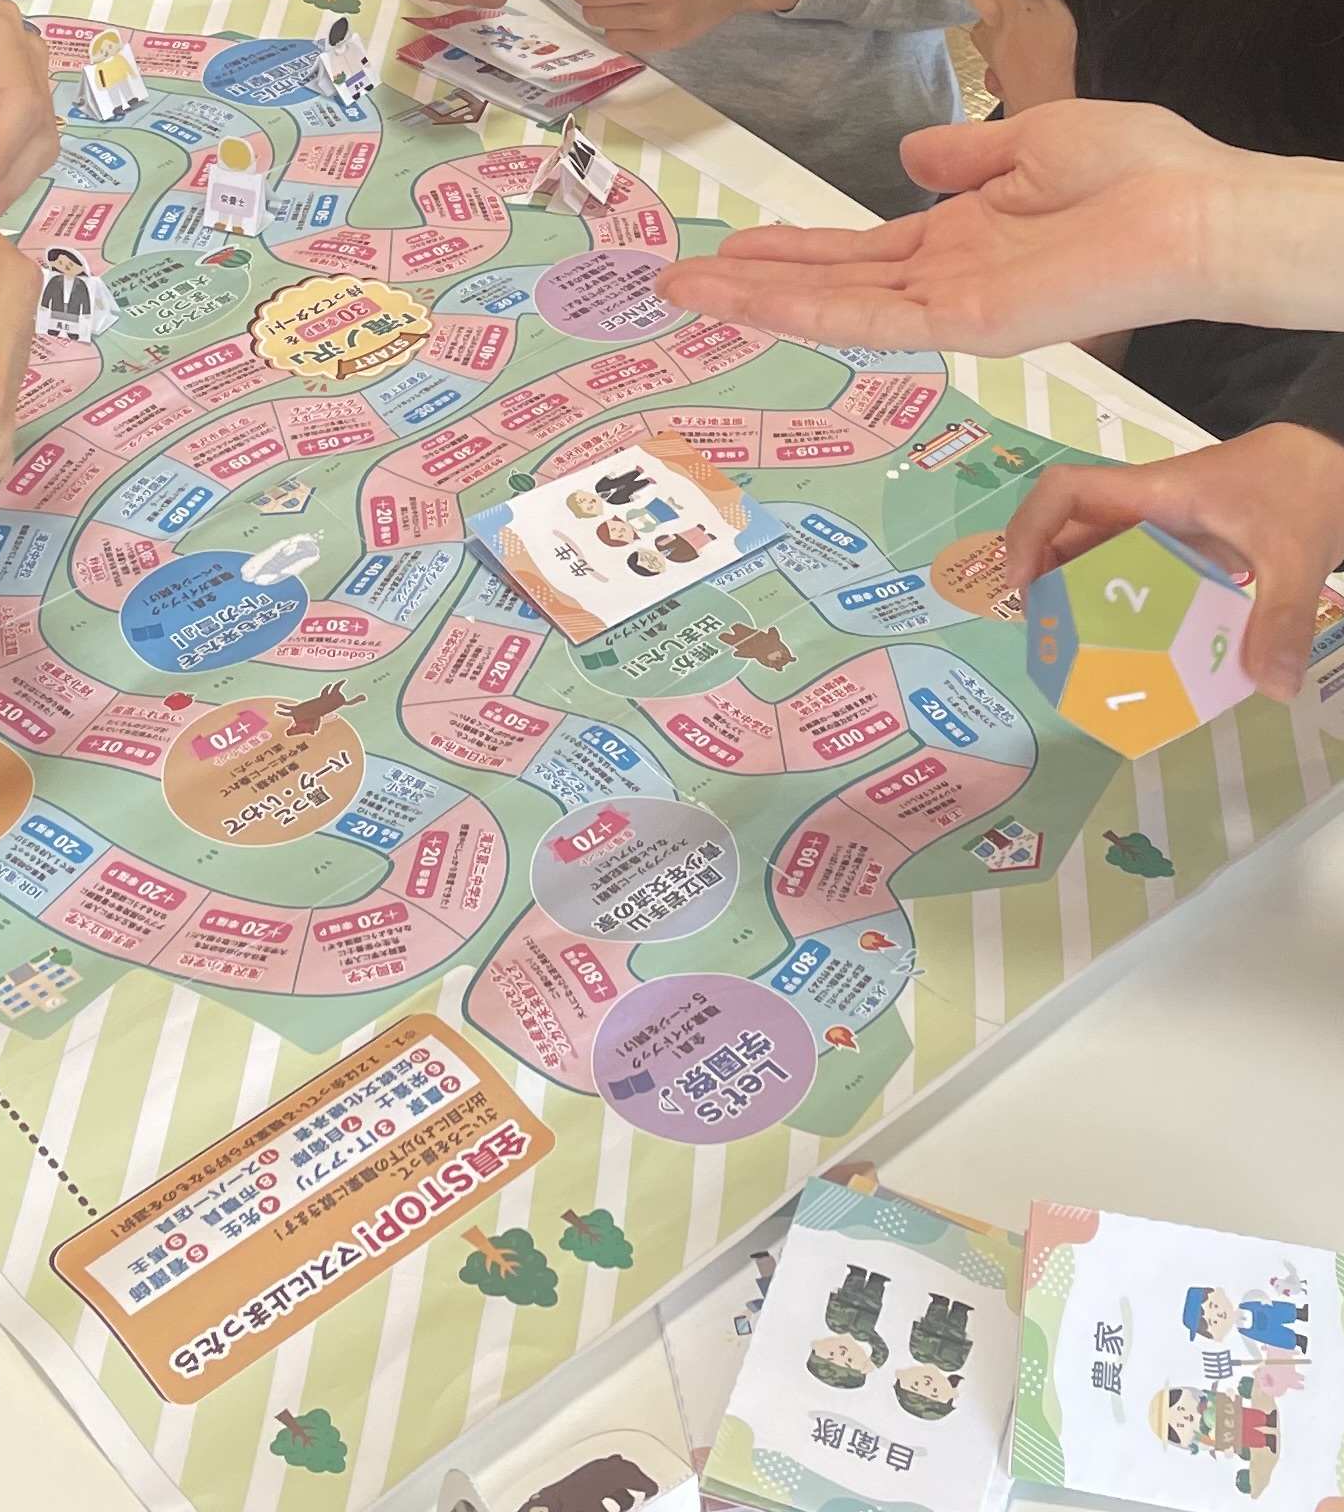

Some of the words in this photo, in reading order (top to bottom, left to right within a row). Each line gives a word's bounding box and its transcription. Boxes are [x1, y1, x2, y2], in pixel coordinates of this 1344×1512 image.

[170, 40, 197, 50] +50
[349, 153, 367, 178] +60
[508, 158, 535, 171] +30
[446, 182, 460, 204] +30
[337, 243, 369, 257] +30
[430, 237, 462, 256] +30
[152, 289, 236, 338] 滝沢スイカ
[155, 287, 210, 321] まつり
[264, 281, 364, 337] 持ってスタート！
[338, 299, 370, 325] 30
[281, 331, 299, 348] を
[284, 304, 418, 372] 「滝ノ沢」
[351, 335, 411, 372] START
[202, 345, 235, 369] +10
[112, 385, 144, 411] +10
[529, 395, 563, 419] +30
[304, 434, 339, 453] +50
[450, 436, 486, 463] +30
[27, 445, 58, 475] +20
[216, 452, 250, 476] +60
[375, 498, 393, 526] +20
[549, 538, 592, 580] 先生
[874, 577, 915, 599] -100
[1104, 577, 1150, 612] 2
[176, 597, 300, 670] 今年も来たぞ
[325, 620, 362, 631] +30
[1039, 616, 1057, 663] 10
[305, 646, 375, 659] CoderDojo
[620, 609, 724, 684] 出ました!!
[668, 634, 723, 680] 熊が
[484, 656, 511, 688] +20
[1105, 691, 1146, 711] 1
[206, 718, 253, 751] +70
[501, 712, 542, 734] +50
[673, 717, 714, 748] +20
[817, 727, 865, 757] +100
[899, 760, 937, 789] +70
[220, 749, 353, 836] パーク・いわて
[271, 785, 331, 828] 馬っこ
[933, 805, 963, 828] 工房
[569, 818, 615, 851] +70
[418, 834, 442, 870] +20
[792, 833, 826, 871] +60
[462, 831, 494, 911] 滝沢第二中学校
[588, 839, 724, 933] 青少年交流の家
[15, 875, 45, 900] IGR
[136, 881, 175, 904] +20
[623, 864, 725, 933] 国立岩手山
[62, 912, 137, 949] 岩手県立大学
[238, 919, 282, 939] +20
[355, 906, 399, 929] +20
[176, 953, 264, 978] 滝沢東小学校
[345, 958, 404, 984] 盛岡大学
[577, 959, 609, 1000] +80
[485, 965, 561, 1066] 岩手産業文化センター
[850, 985, 889, 1018] 火事だ
[671, 1026, 776, 1100] 学園祭
[692, 1057, 787, 1124] Let's
[353, 1119, 530, 1255] 全員STOP!
[170, 1239, 362, 1378] マスに止まったら
[1090, 1319, 1125, 1397] 農家
[810, 1416, 915, 1473] 自衛隊
